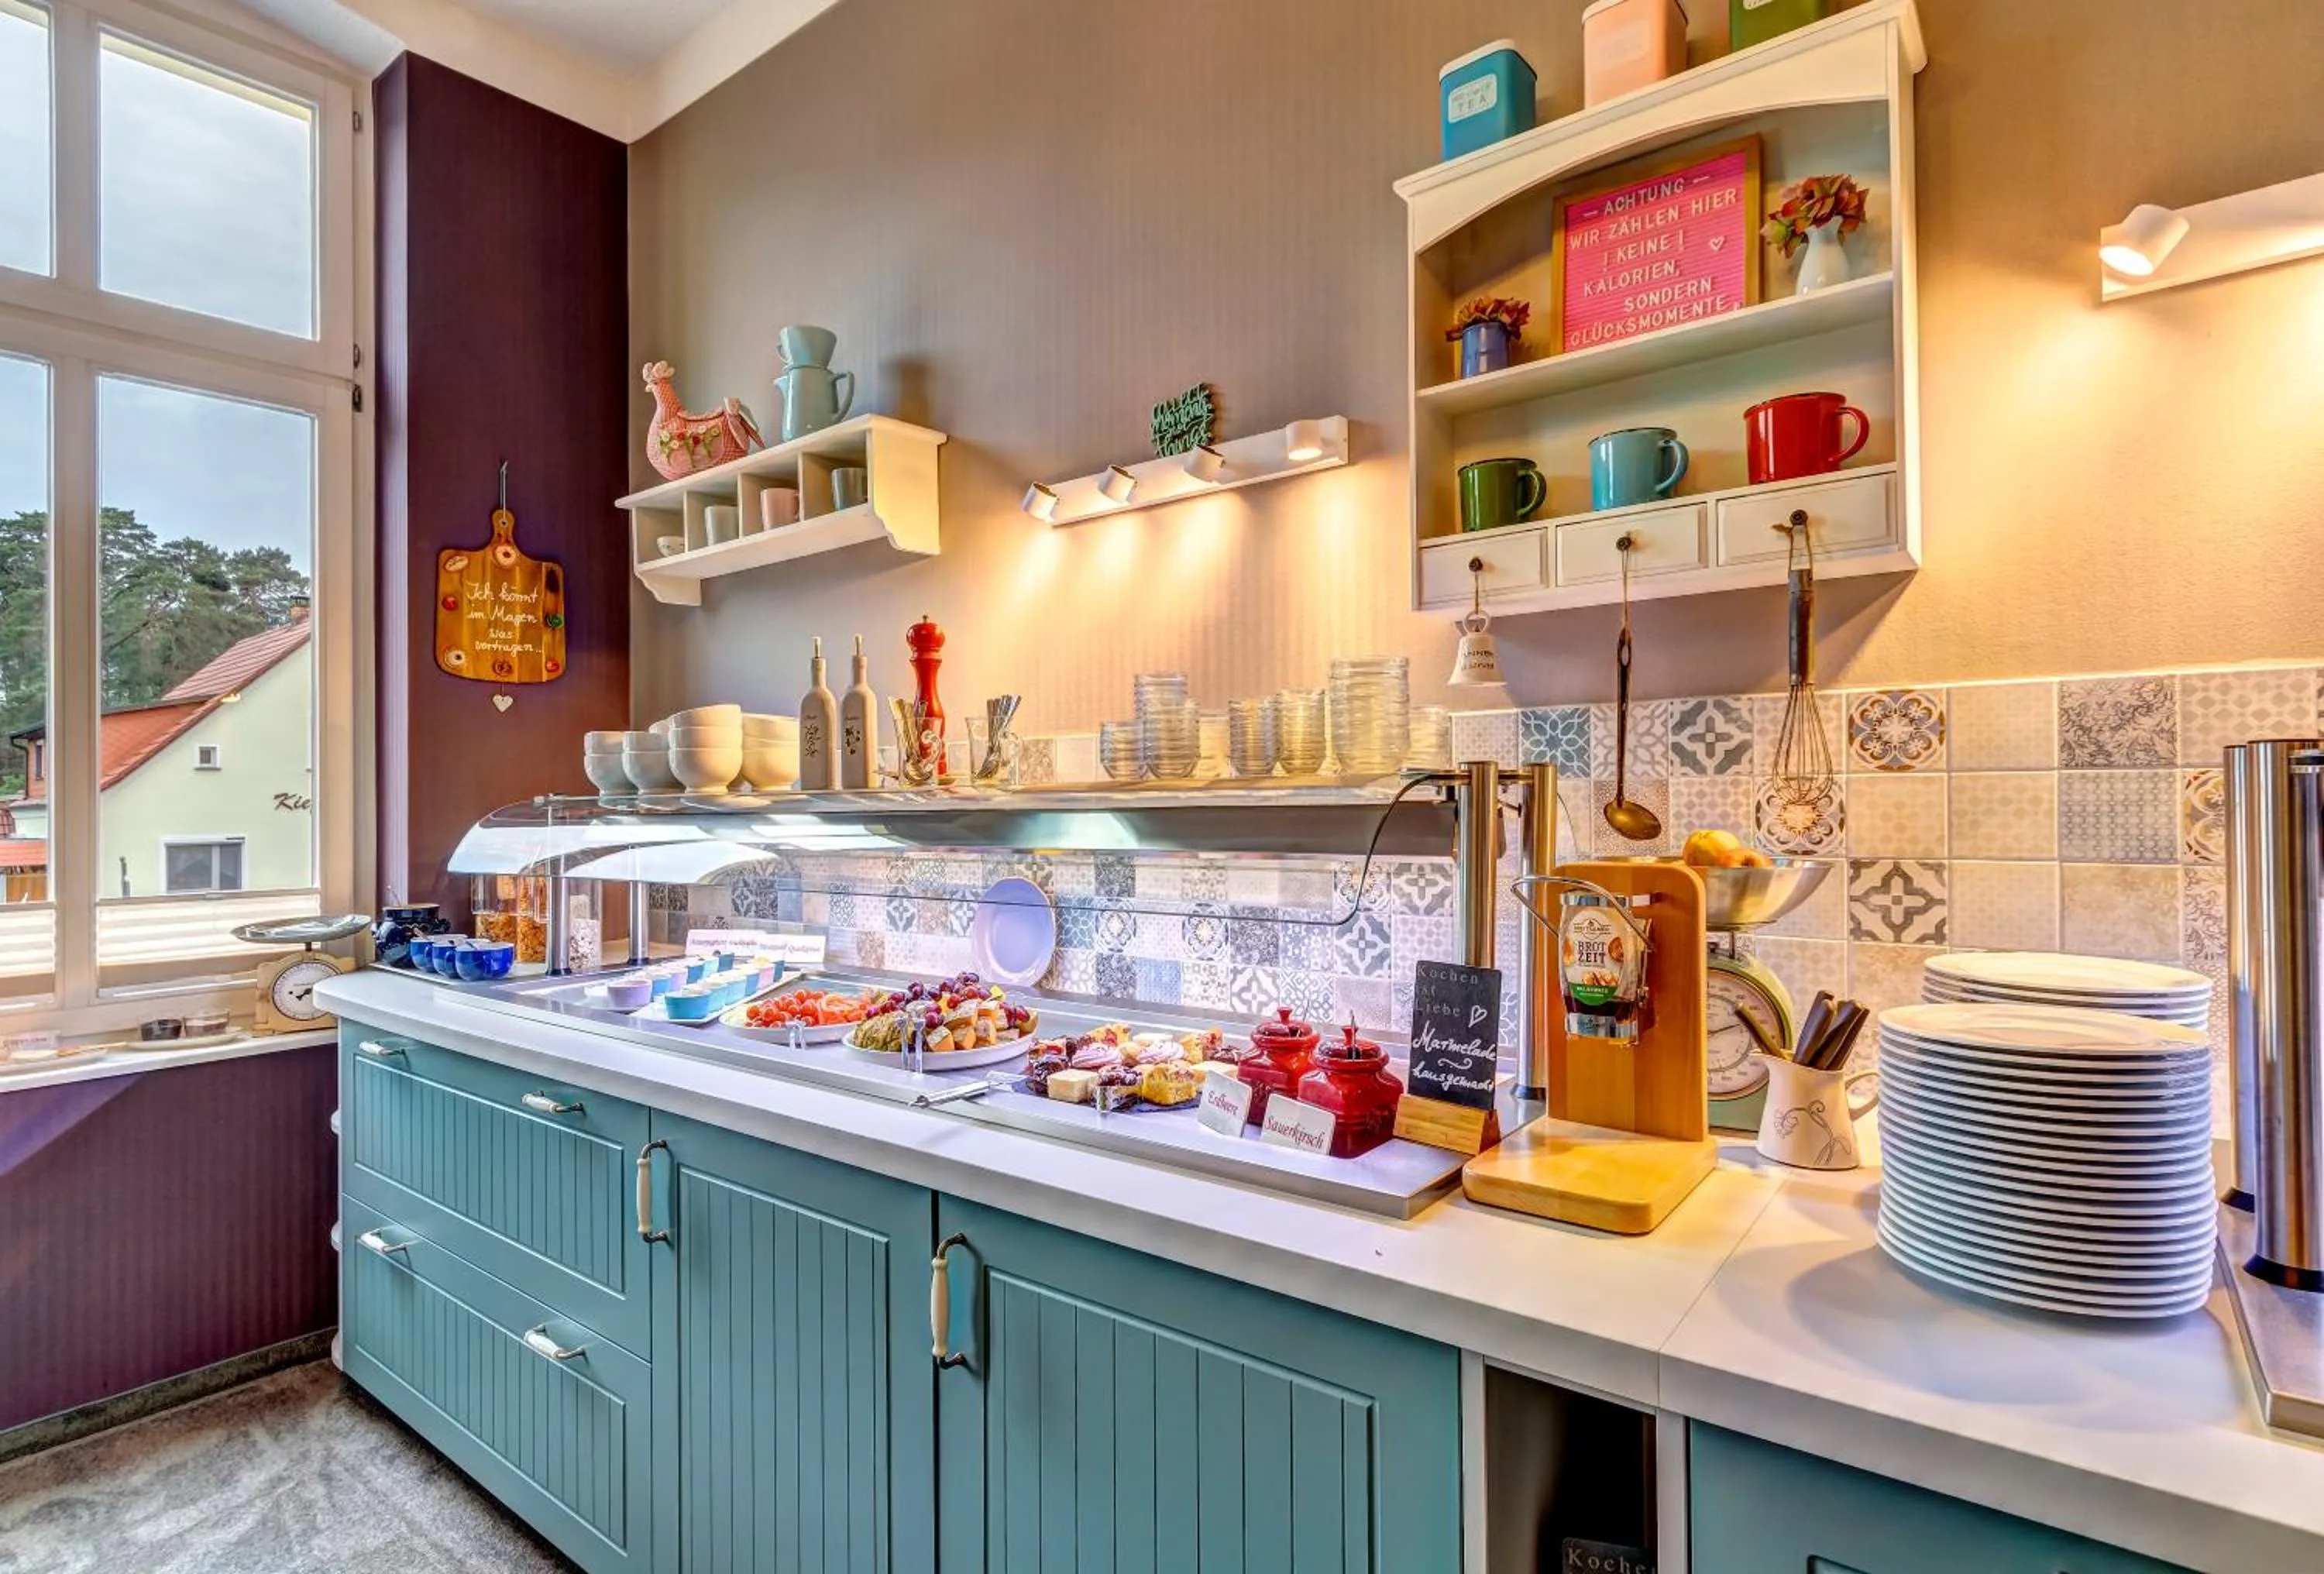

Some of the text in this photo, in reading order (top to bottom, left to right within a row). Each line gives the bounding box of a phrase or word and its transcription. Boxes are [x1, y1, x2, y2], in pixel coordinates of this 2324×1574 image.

[1604, 177, 1685, 215] ACHTUNG
[1570, 188, 1737, 249] WIR ZÄHLEN HIER
[1617, 234, 1671, 263] KEINE
[1584, 259, 1681, 297] KALORIEN,
[1624, 277, 1712, 312] SONDERN
[1570, 296, 1726, 347] GLÜCKSMOMENTE
[466, 580, 494, 600] Ich
[466, 603, 538, 627] im Magen
[1578, 940, 1606, 952] BROT
[1578, 952, 1606, 964] ZEIT
[1418, 965, 1479, 985] Kochen
[1415, 998, 1461, 1016] Liebe
[1412, 1020, 1497, 1061] Marmelade
[1264, 1115, 1325, 1149] Sauerkirsch
